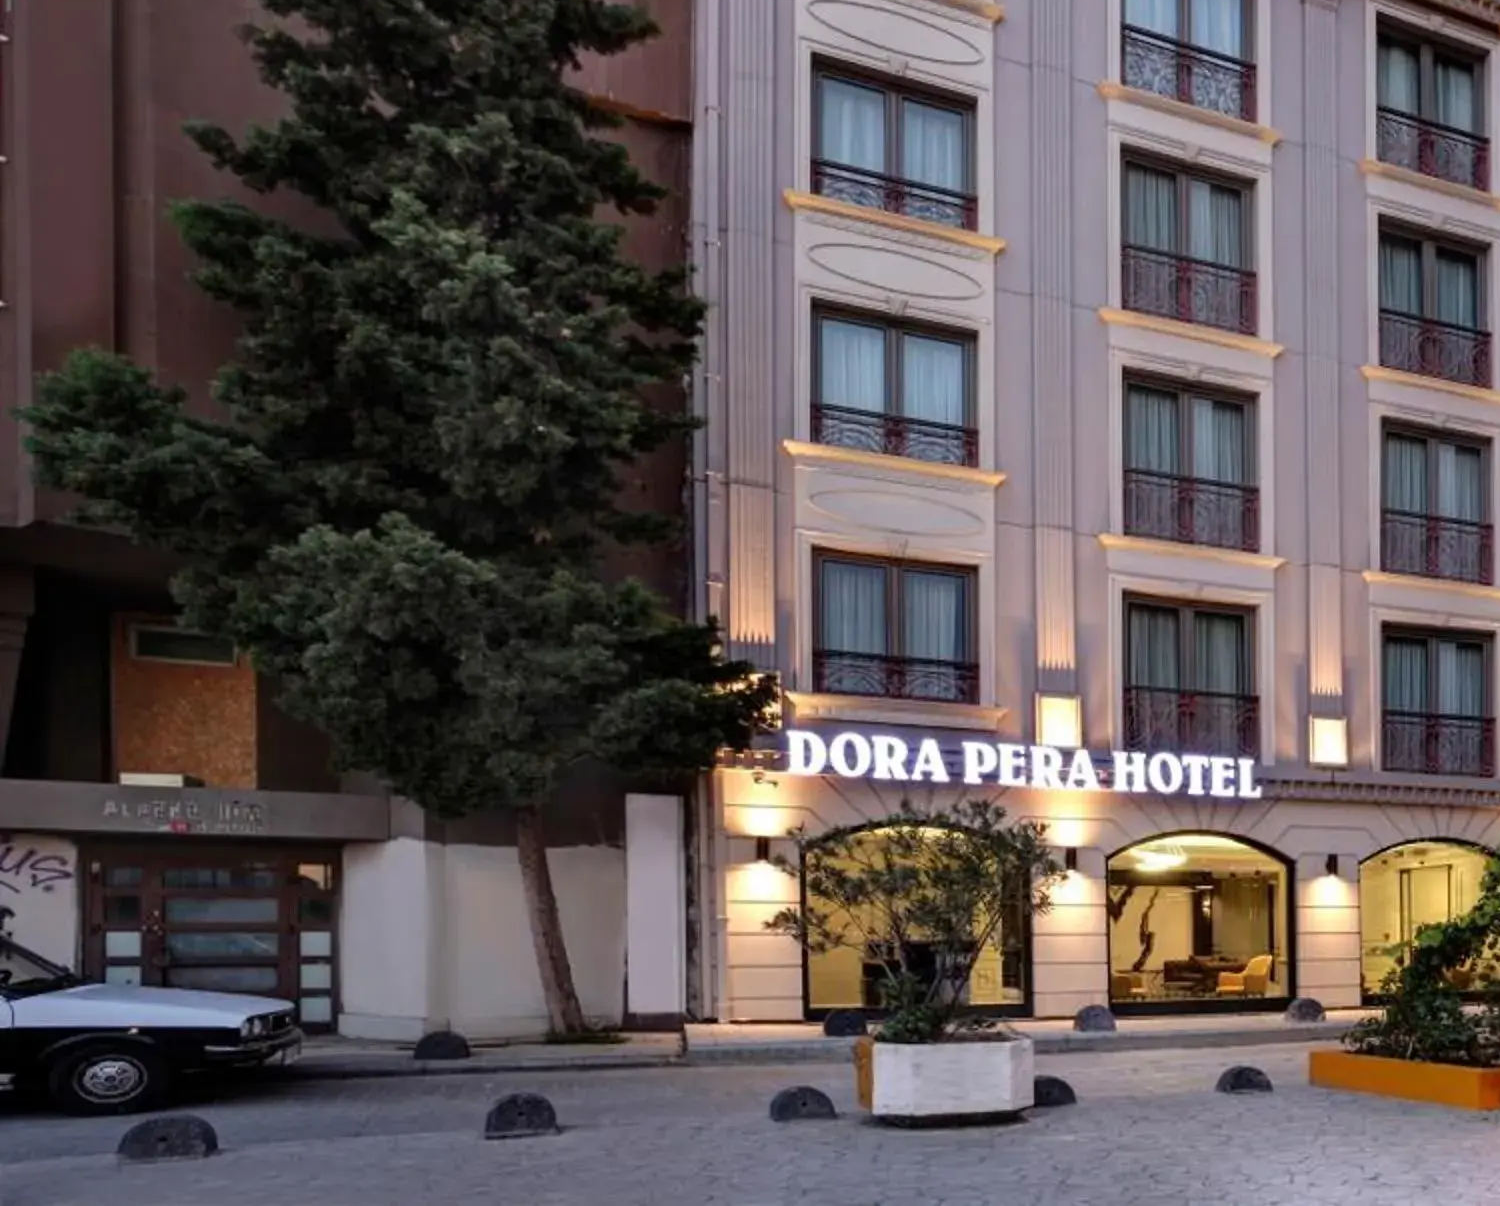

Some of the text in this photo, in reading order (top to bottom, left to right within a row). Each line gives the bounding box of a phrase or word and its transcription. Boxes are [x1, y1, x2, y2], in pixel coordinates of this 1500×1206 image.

[785, 729, 1263, 799] DORA PERA HOTEL
